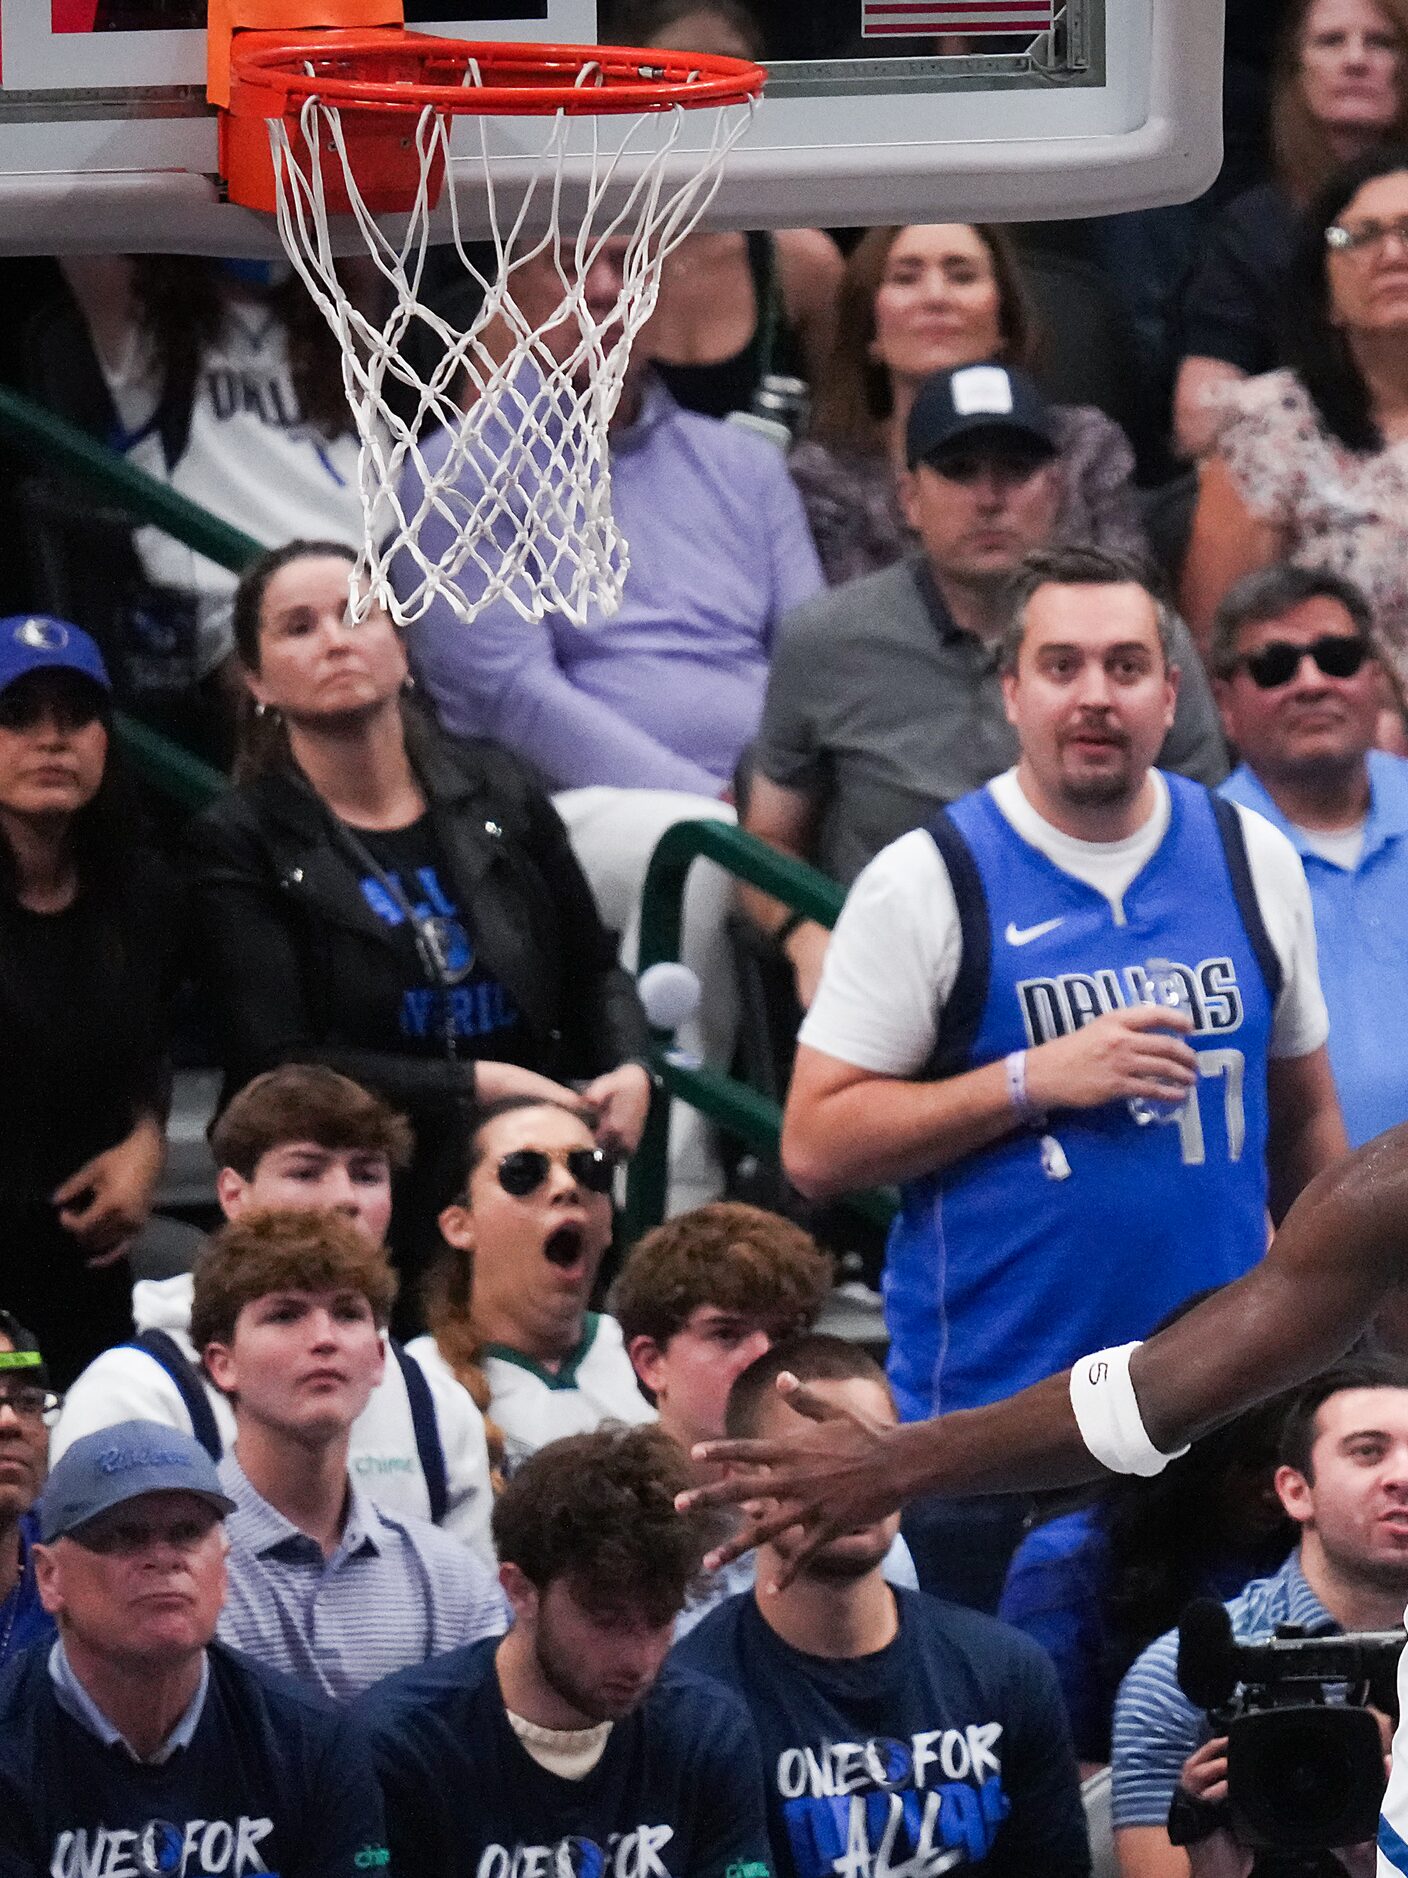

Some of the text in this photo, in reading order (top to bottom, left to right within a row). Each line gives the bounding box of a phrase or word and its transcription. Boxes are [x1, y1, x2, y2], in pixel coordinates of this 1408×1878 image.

[1088, 1362, 1108, 1386] 5
[911, 1719, 1004, 1789] FOR
[179, 1815, 276, 1878] FOR
